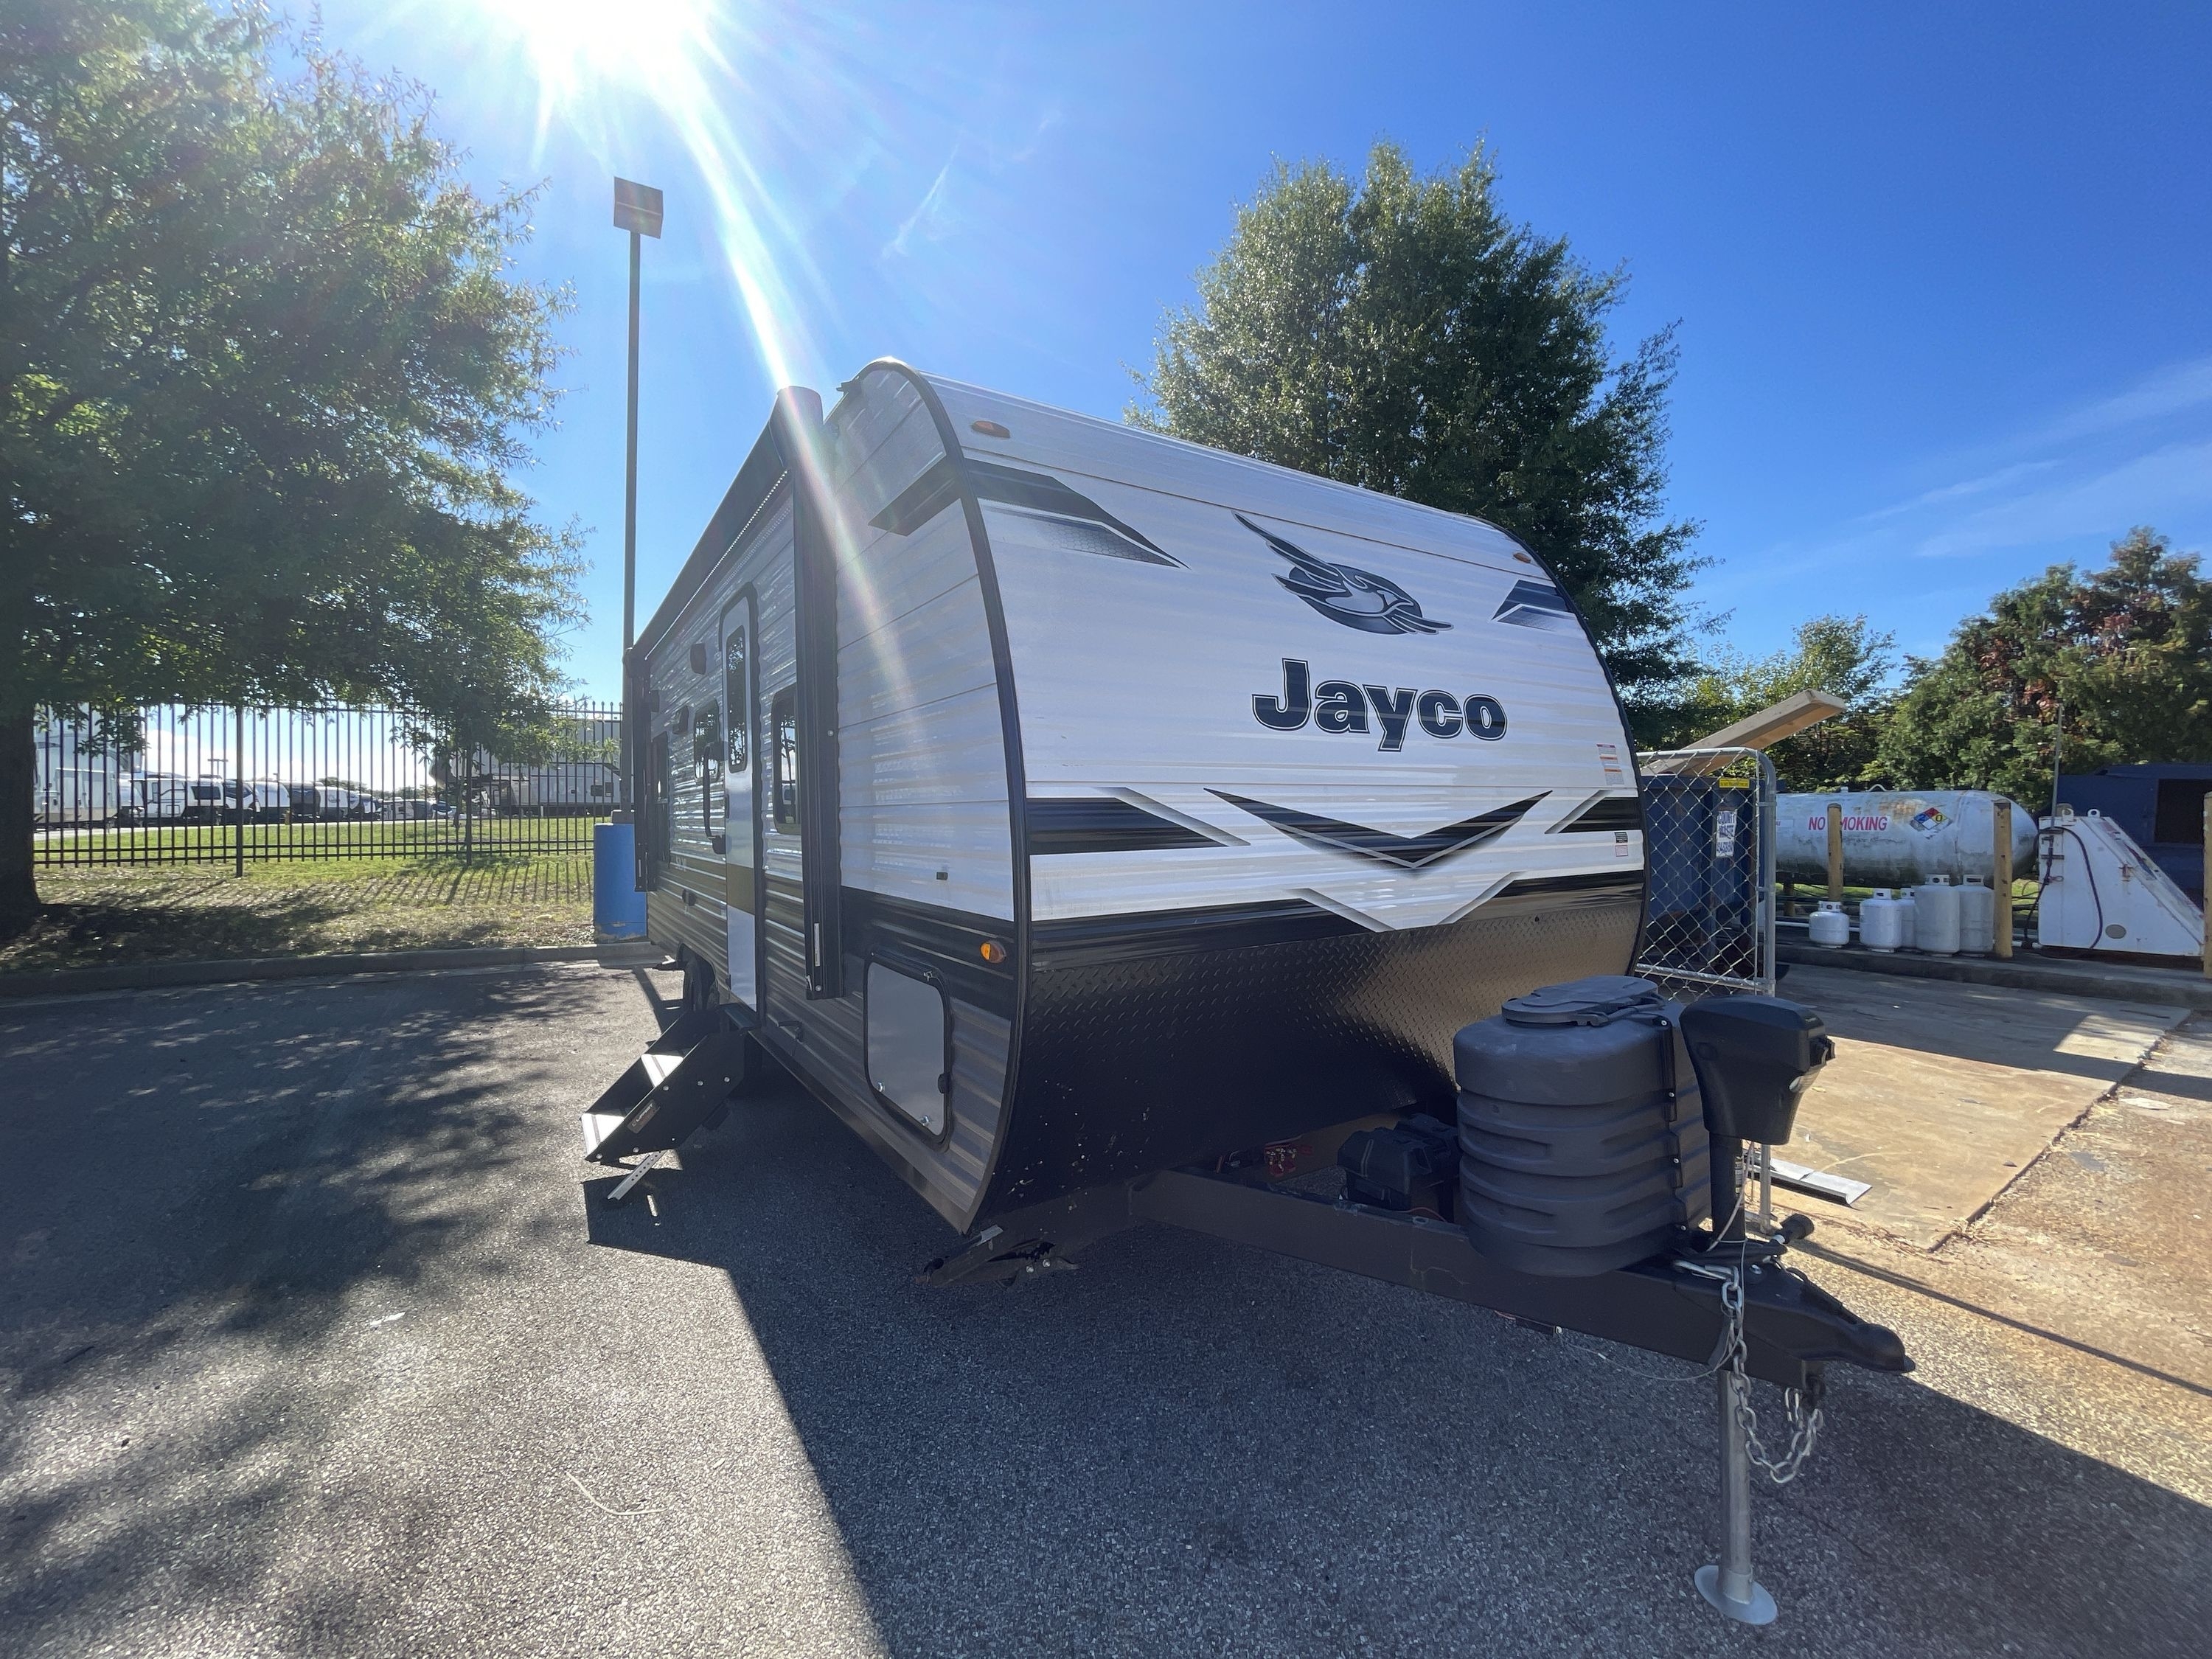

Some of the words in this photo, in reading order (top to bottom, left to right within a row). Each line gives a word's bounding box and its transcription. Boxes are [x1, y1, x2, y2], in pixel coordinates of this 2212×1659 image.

[1251, 657, 1508, 752] Jayco
[1918, 813, 1926, 821] 2
[1935, 814, 1943, 822] 0
[1808, 816, 1826, 830] NO
[1840, 816, 1888, 831] MOKING
